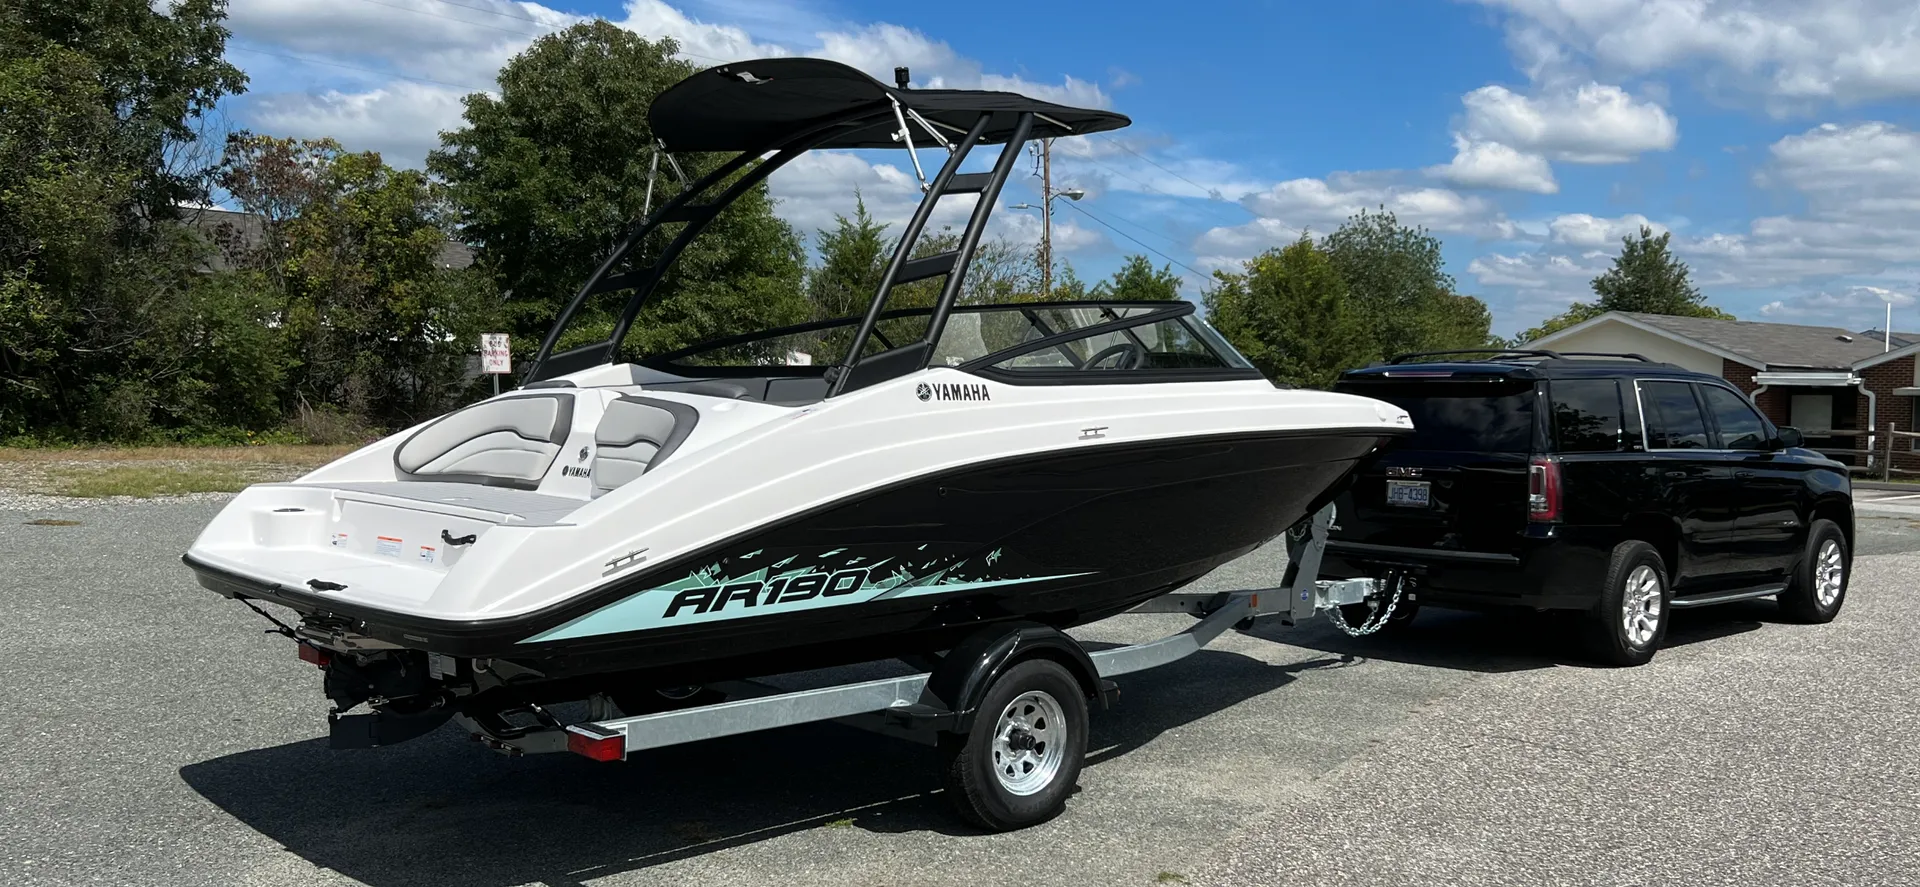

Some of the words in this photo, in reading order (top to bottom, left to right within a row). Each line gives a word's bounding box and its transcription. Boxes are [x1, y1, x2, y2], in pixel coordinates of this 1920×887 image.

[932, 383, 991, 401] YAMAHA
[569, 466, 591, 478] YAMAHA
[1386, 466, 1422, 477] GMC
[1389, 487, 1428, 501] JHB-4398
[661, 568, 871, 618] AR190
